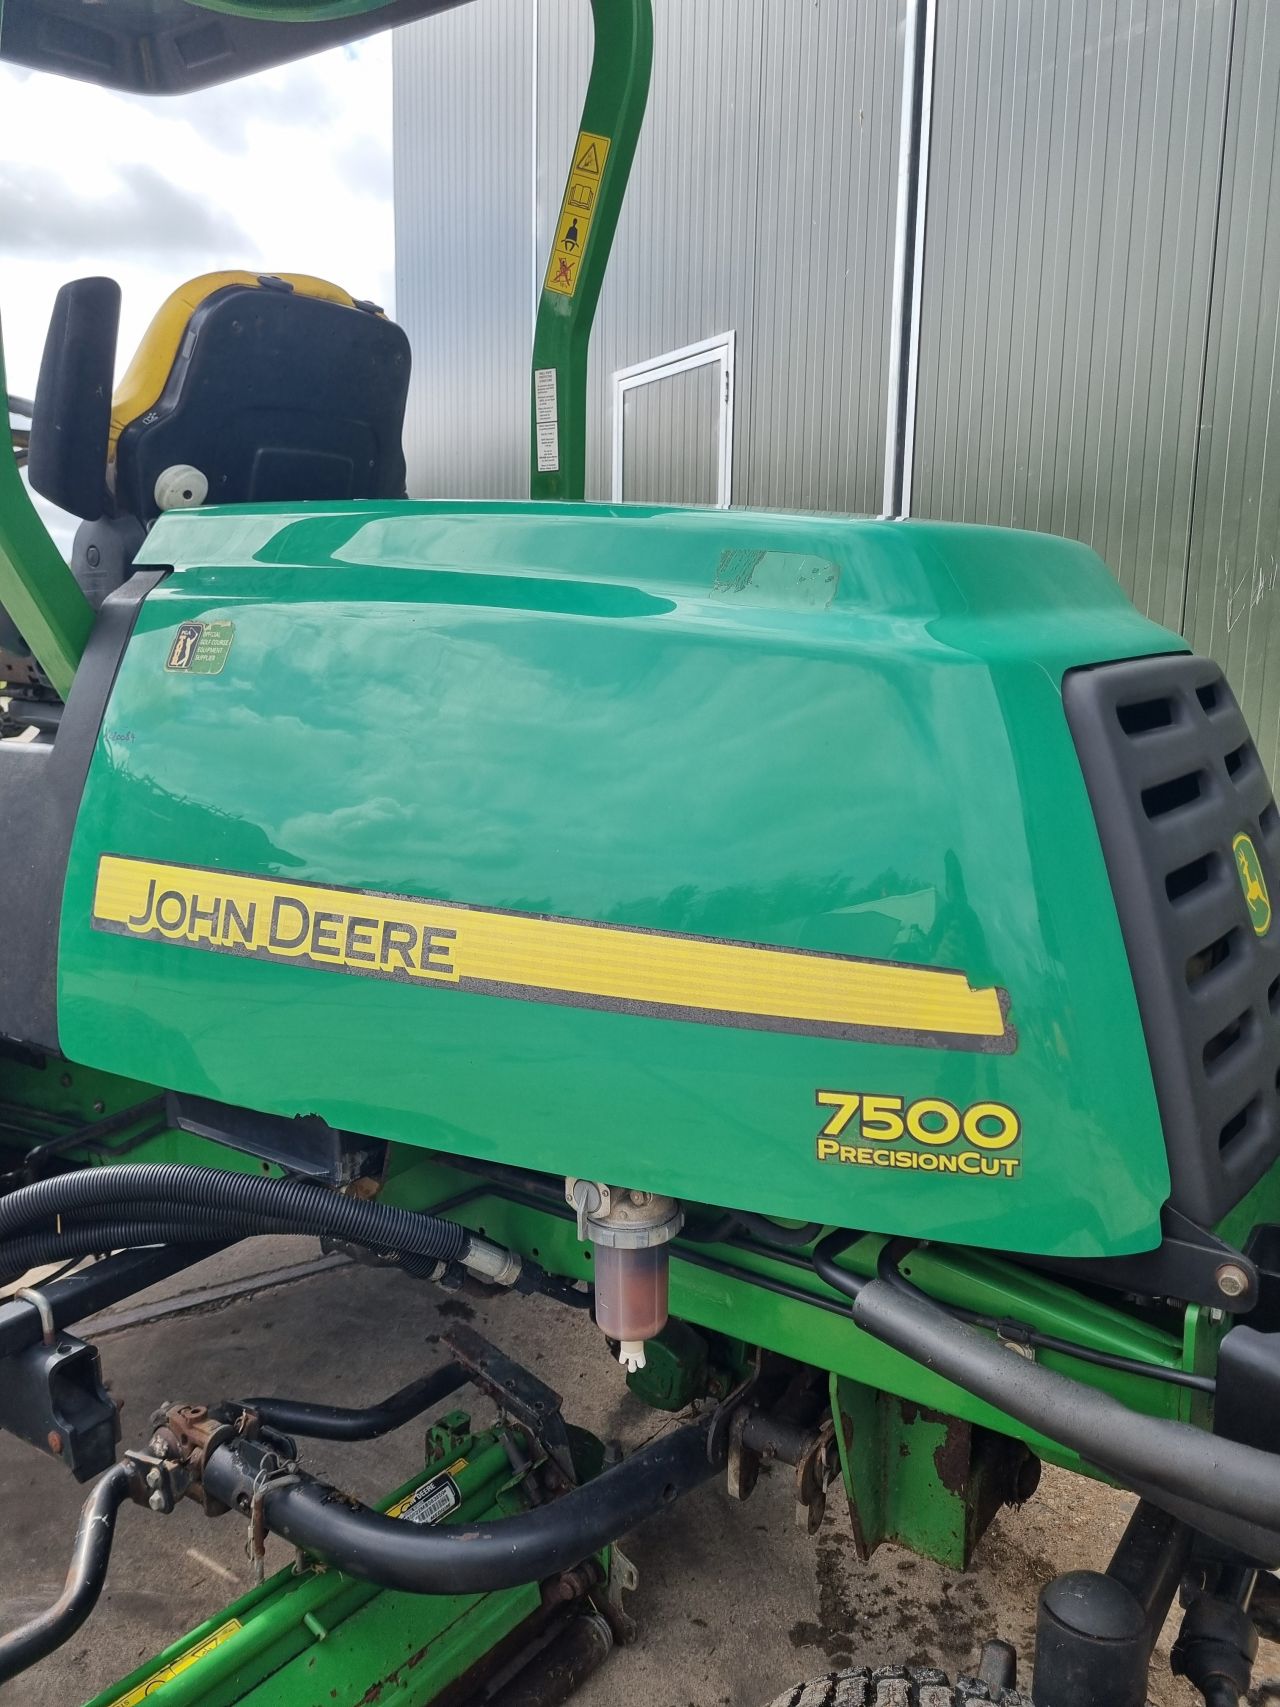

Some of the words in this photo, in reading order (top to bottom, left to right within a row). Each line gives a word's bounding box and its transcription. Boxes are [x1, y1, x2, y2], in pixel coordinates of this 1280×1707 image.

[129, 879, 257, 943] JOHN
[269, 896, 457, 974] DEERE
[816, 1089, 1022, 1151] 7500
[416, 1482, 437, 1500] DEERE
